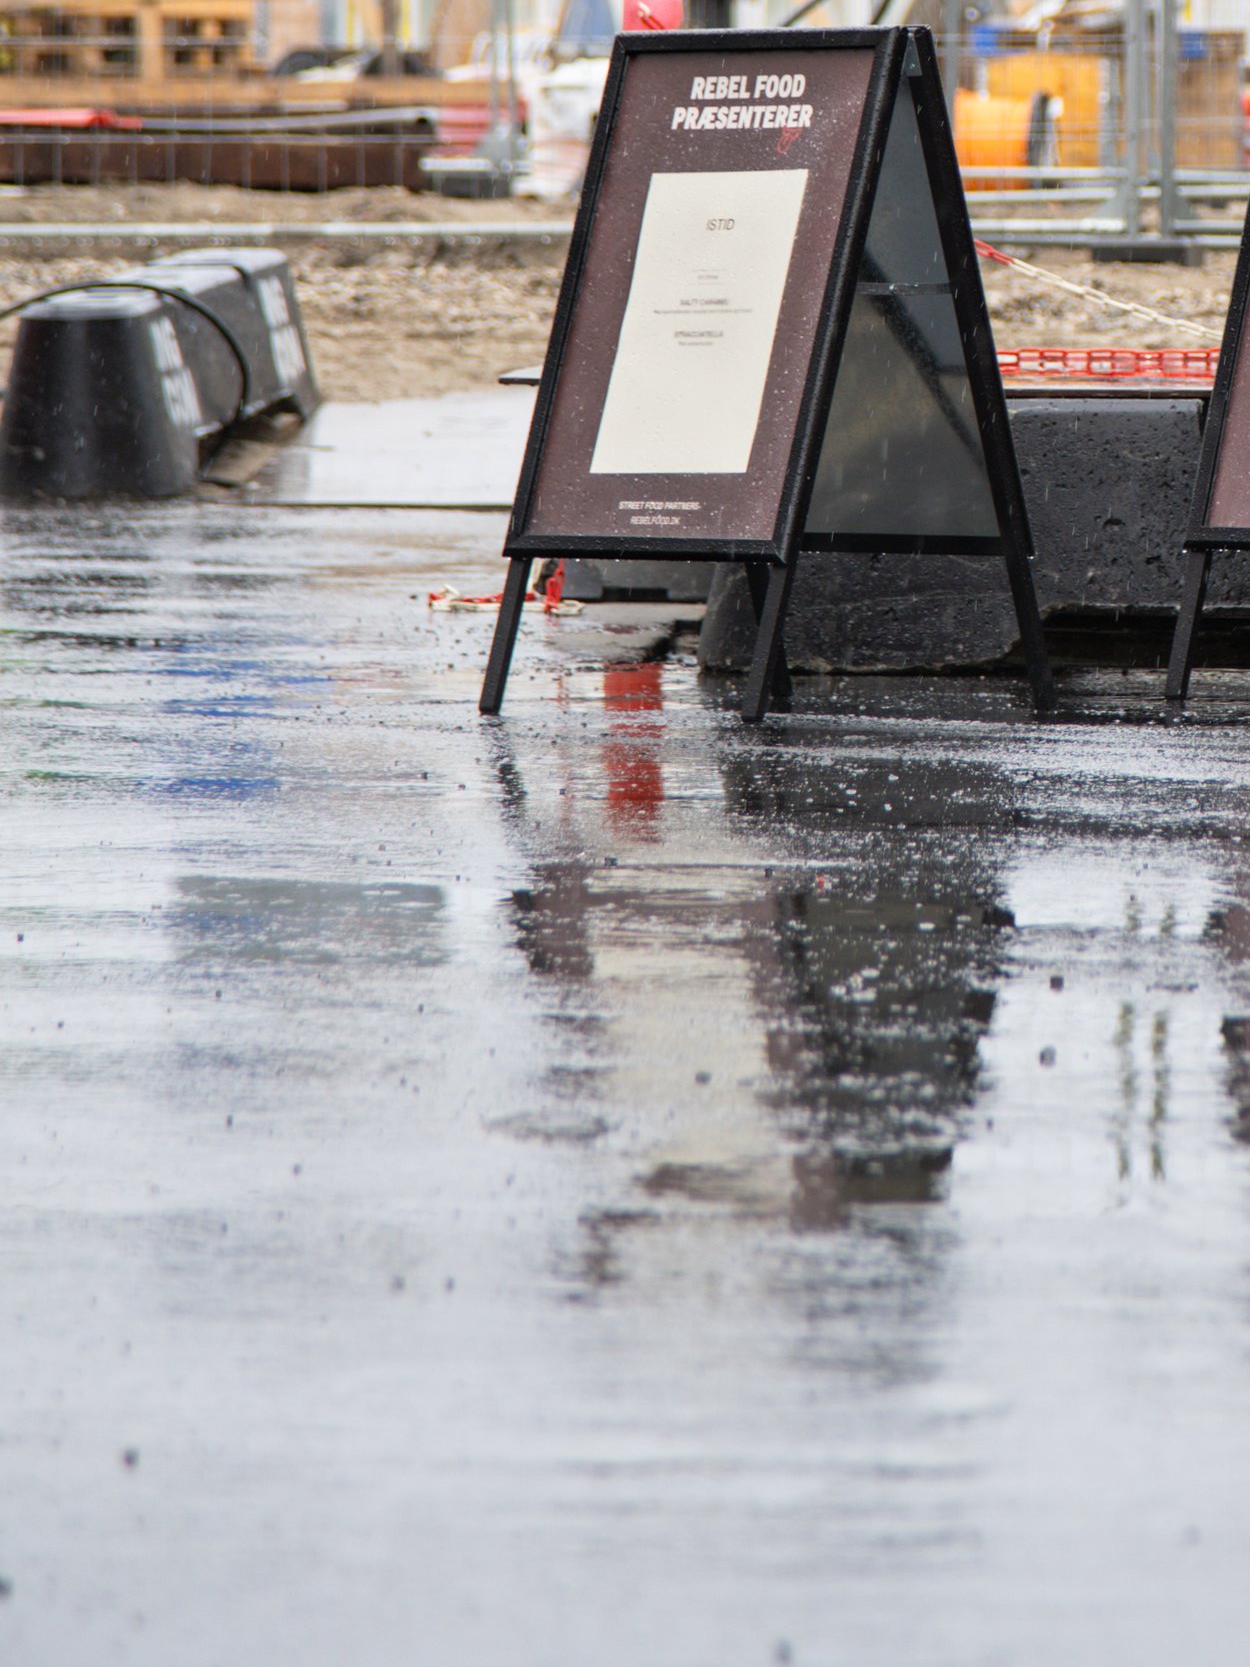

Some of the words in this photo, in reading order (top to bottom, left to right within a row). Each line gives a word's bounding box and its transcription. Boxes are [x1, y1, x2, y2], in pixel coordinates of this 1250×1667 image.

[690, 75, 750, 100] REBEL
[753, 74, 806, 99] FOOD
[671, 104, 814, 130] PRÆSENTERER
[706, 218, 736, 231] ISTID
[619, 501, 645, 510] STREET
[645, 501, 664, 510] FOOD
[664, 501, 700, 511] PARTNERS
